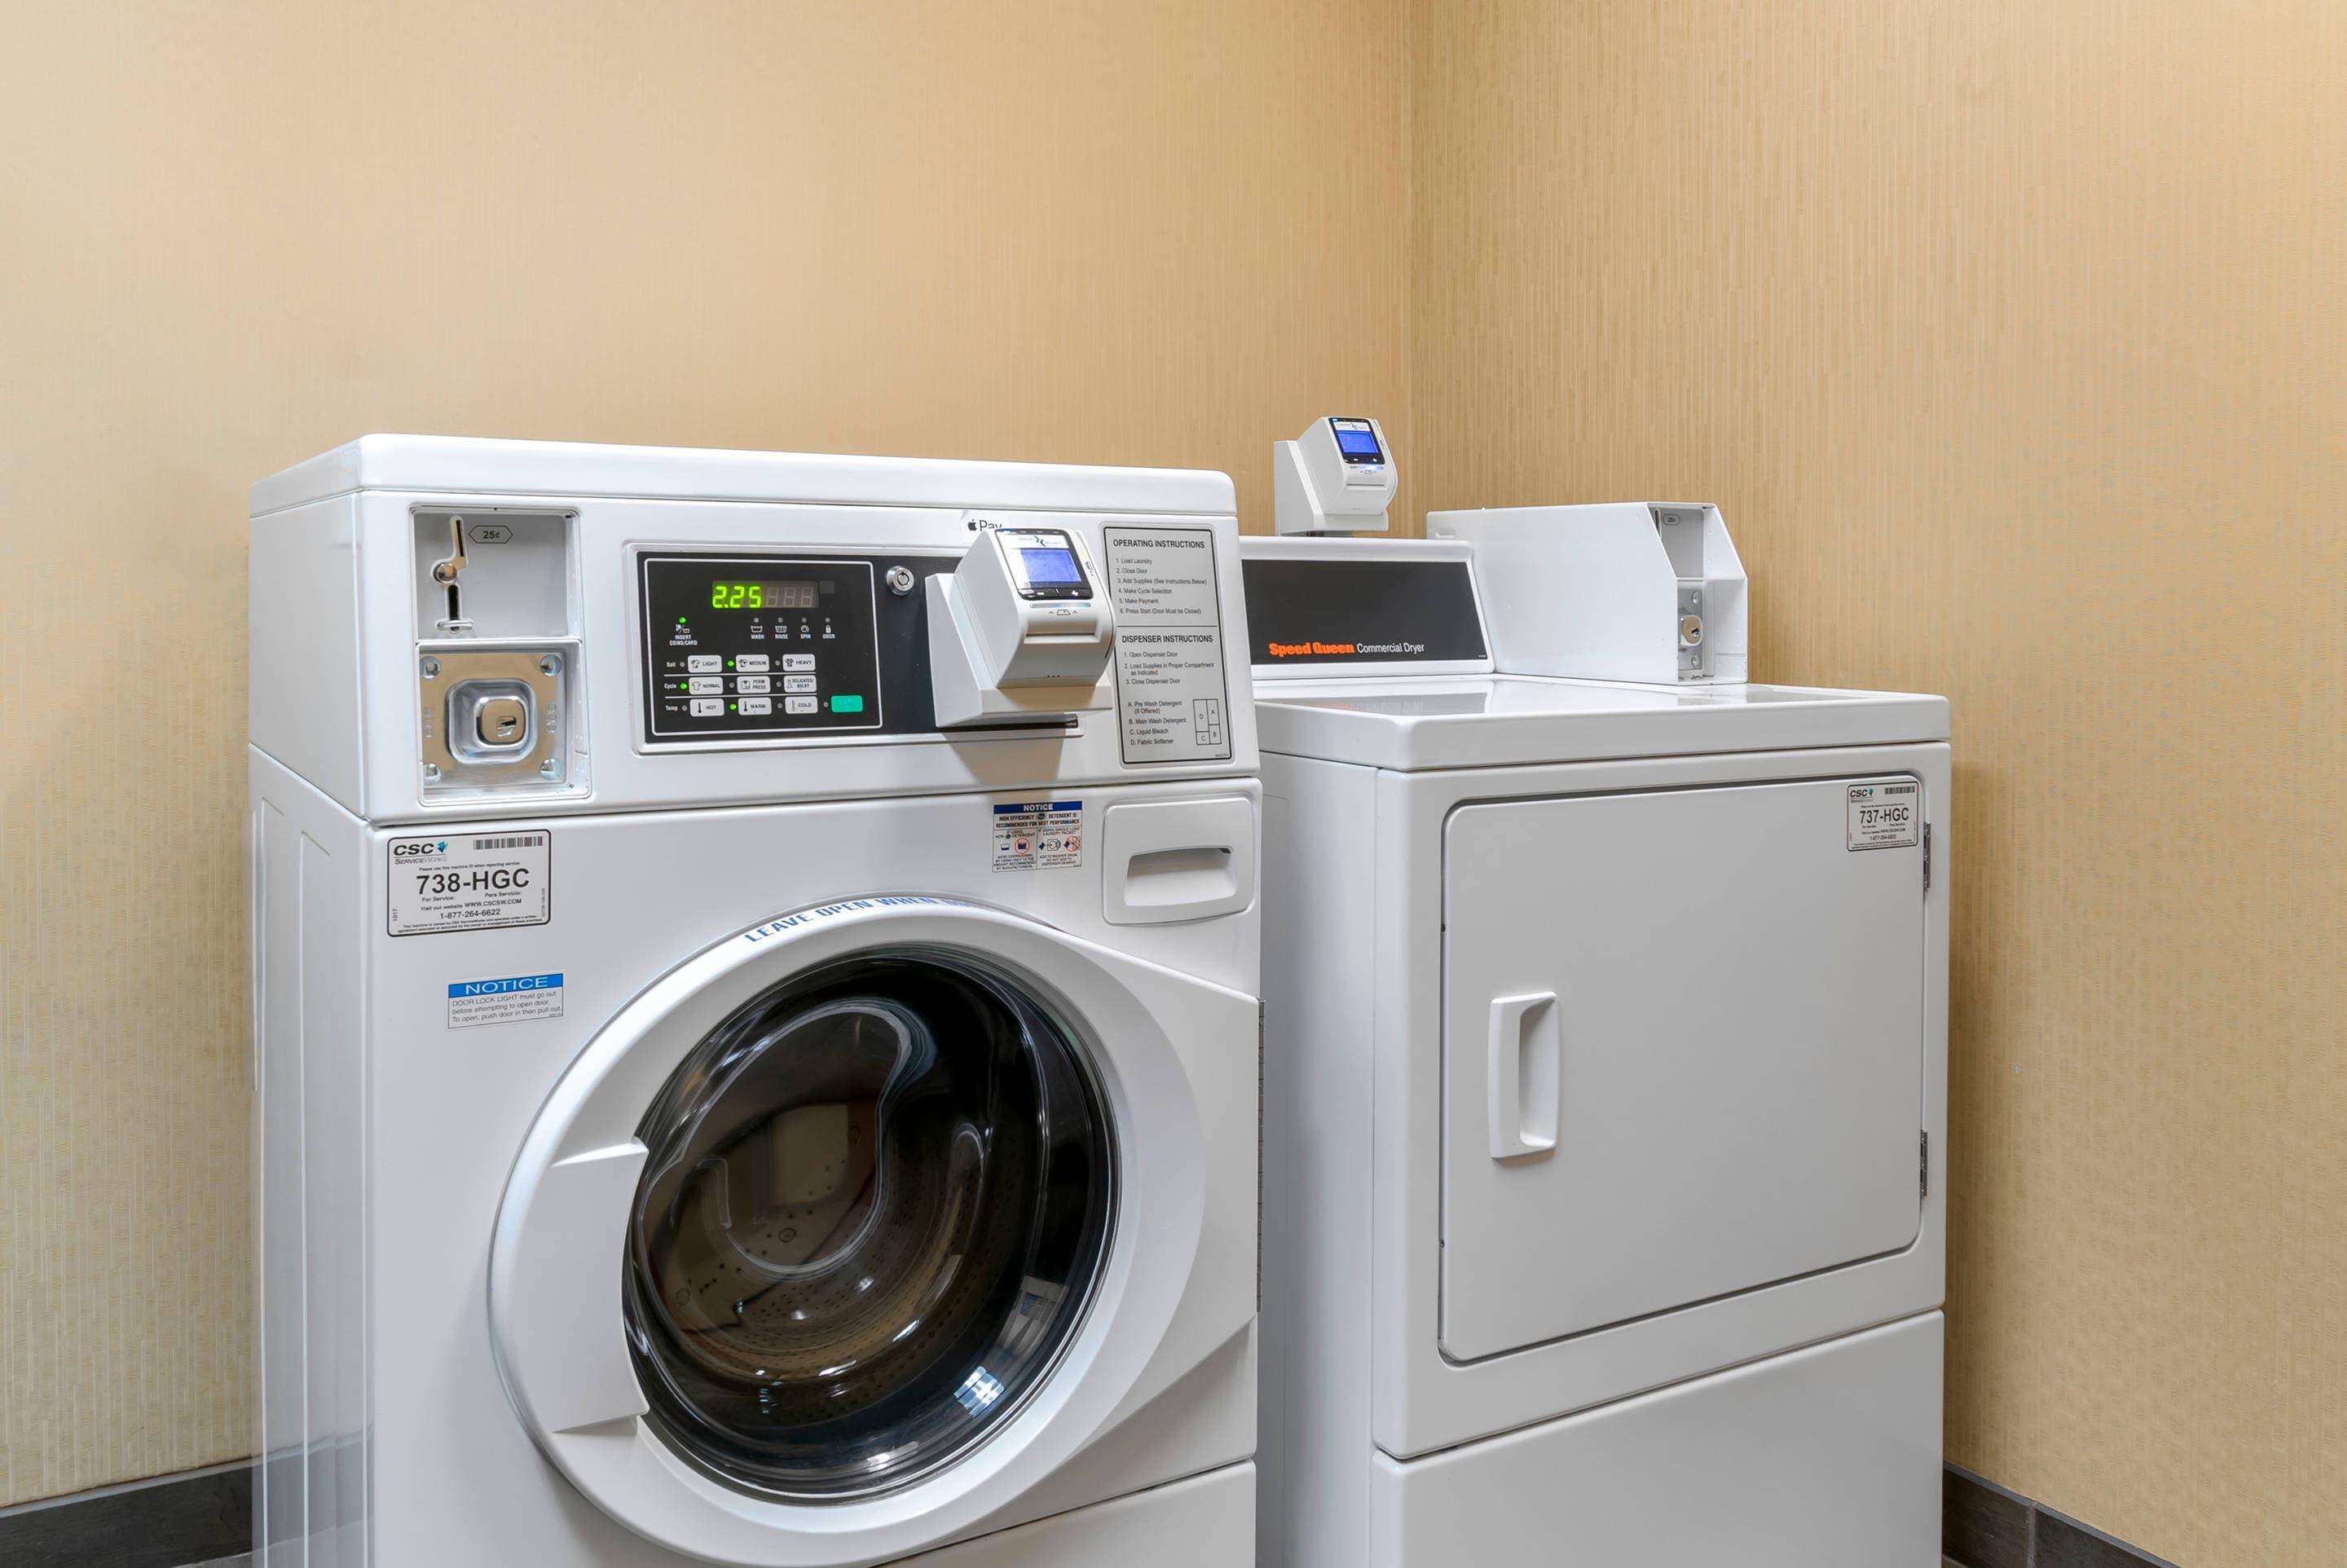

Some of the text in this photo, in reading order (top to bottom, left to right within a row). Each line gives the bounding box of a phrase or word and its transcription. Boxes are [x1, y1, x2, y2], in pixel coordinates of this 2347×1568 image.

[1113, 540, 1205, 548] OPERATING INSTRUCTIONS
[712, 585, 761, 608] 2.25
[1122, 635, 1161, 643] DISPENSER
[1268, 641, 1424, 657] Speed Queen Commercial Dryer
[1850, 789, 1868, 797] CSC
[1024, 804, 1054, 812] NOTICE
[1860, 808, 1909, 824] 737-HGC
[394, 843, 434, 856] CSC
[416, 868, 530, 895] 738-HGC
[465, 898, 522, 907] WWW.CSCSW.COM
[440, 909, 500, 919] 1-877-264-6622
[745, 914, 813, 942] LEAVE
[815, 900, 873, 917] OPEN
[876, 896, 939, 906] WHEN
[465, 976, 548, 995] NOTICE
[452, 999, 473, 1007] DOOR
[475, 997, 495, 1005] LOCK
[497, 994, 517, 1002] LIGHT
[474, 1004, 508, 1012] attempting
